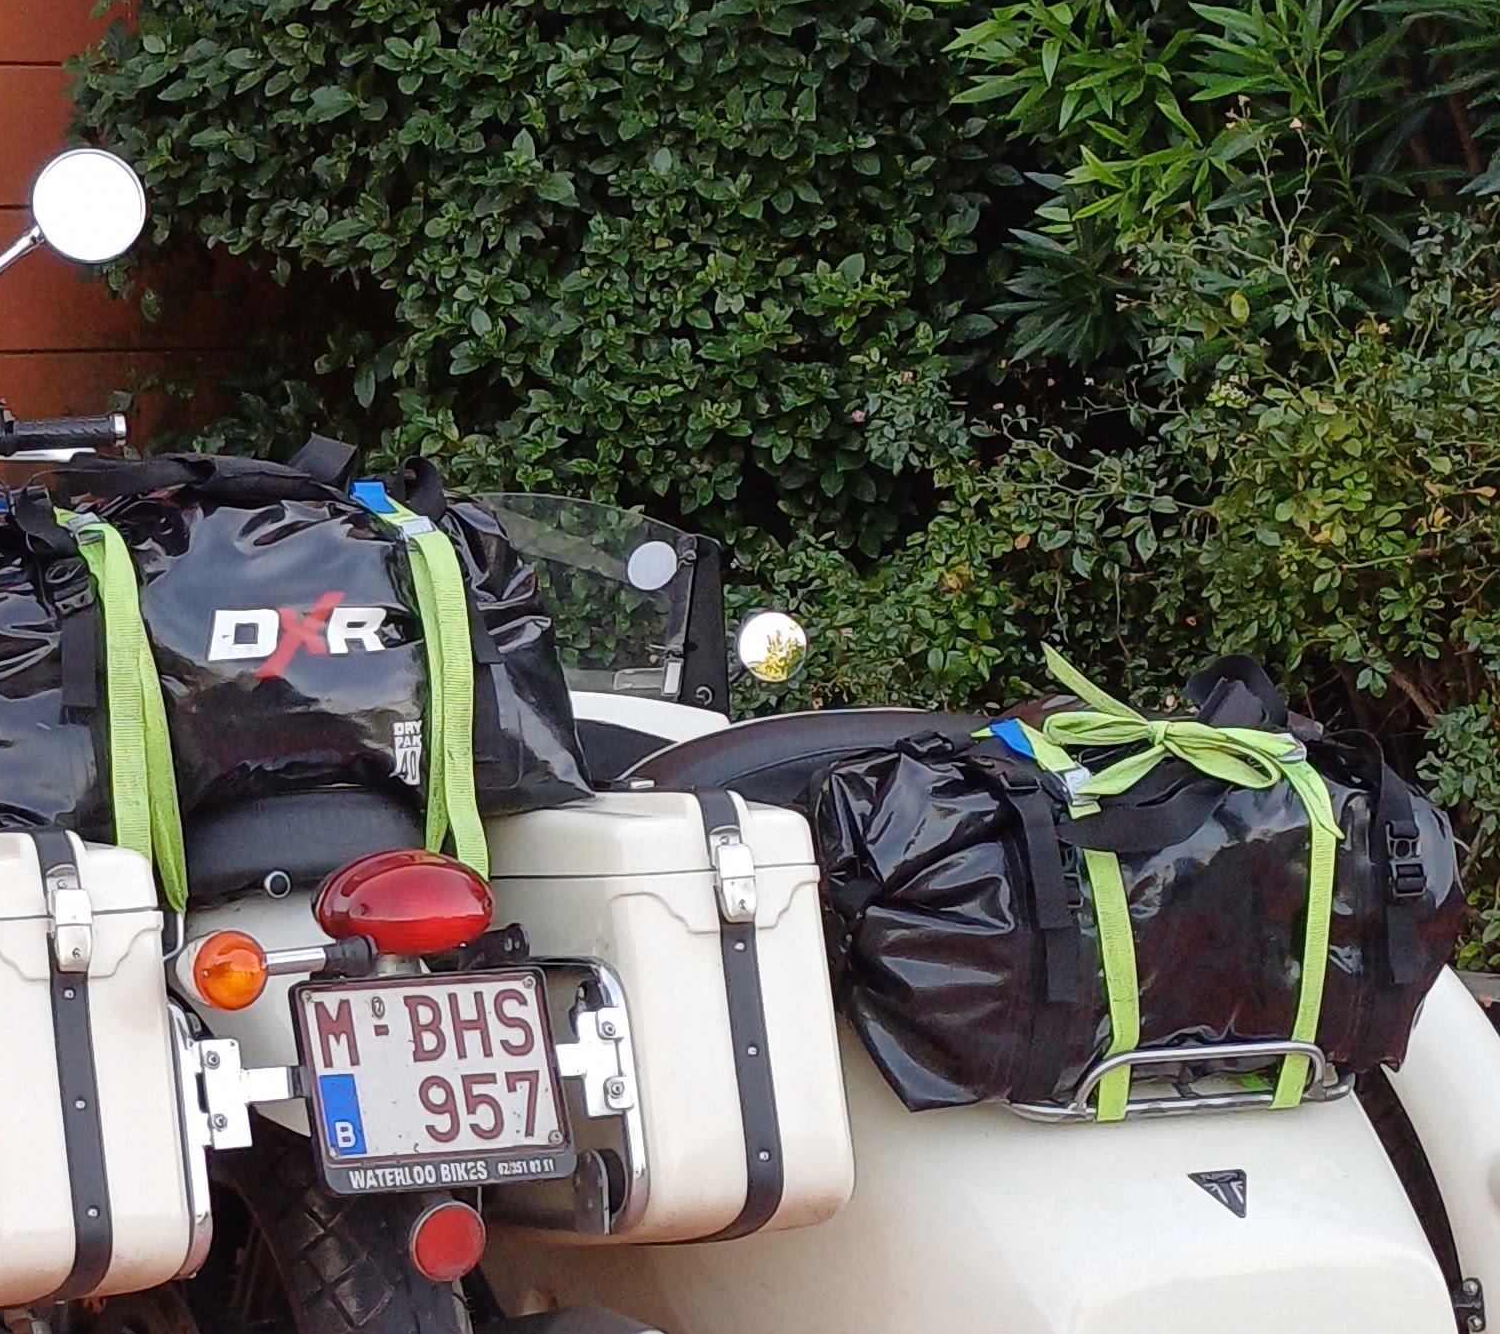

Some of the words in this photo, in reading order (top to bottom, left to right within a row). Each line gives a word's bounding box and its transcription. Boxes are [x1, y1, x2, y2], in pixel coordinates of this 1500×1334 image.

[206, 590, 387, 681] DXR
[393, 720, 423, 736] DRY
[418, 1070, 540, 1143] 957
[334, 1121, 357, 1148] B
[349, 1165, 437, 1190] WATERLOO
[440, 1160, 488, 1183] BIKES
